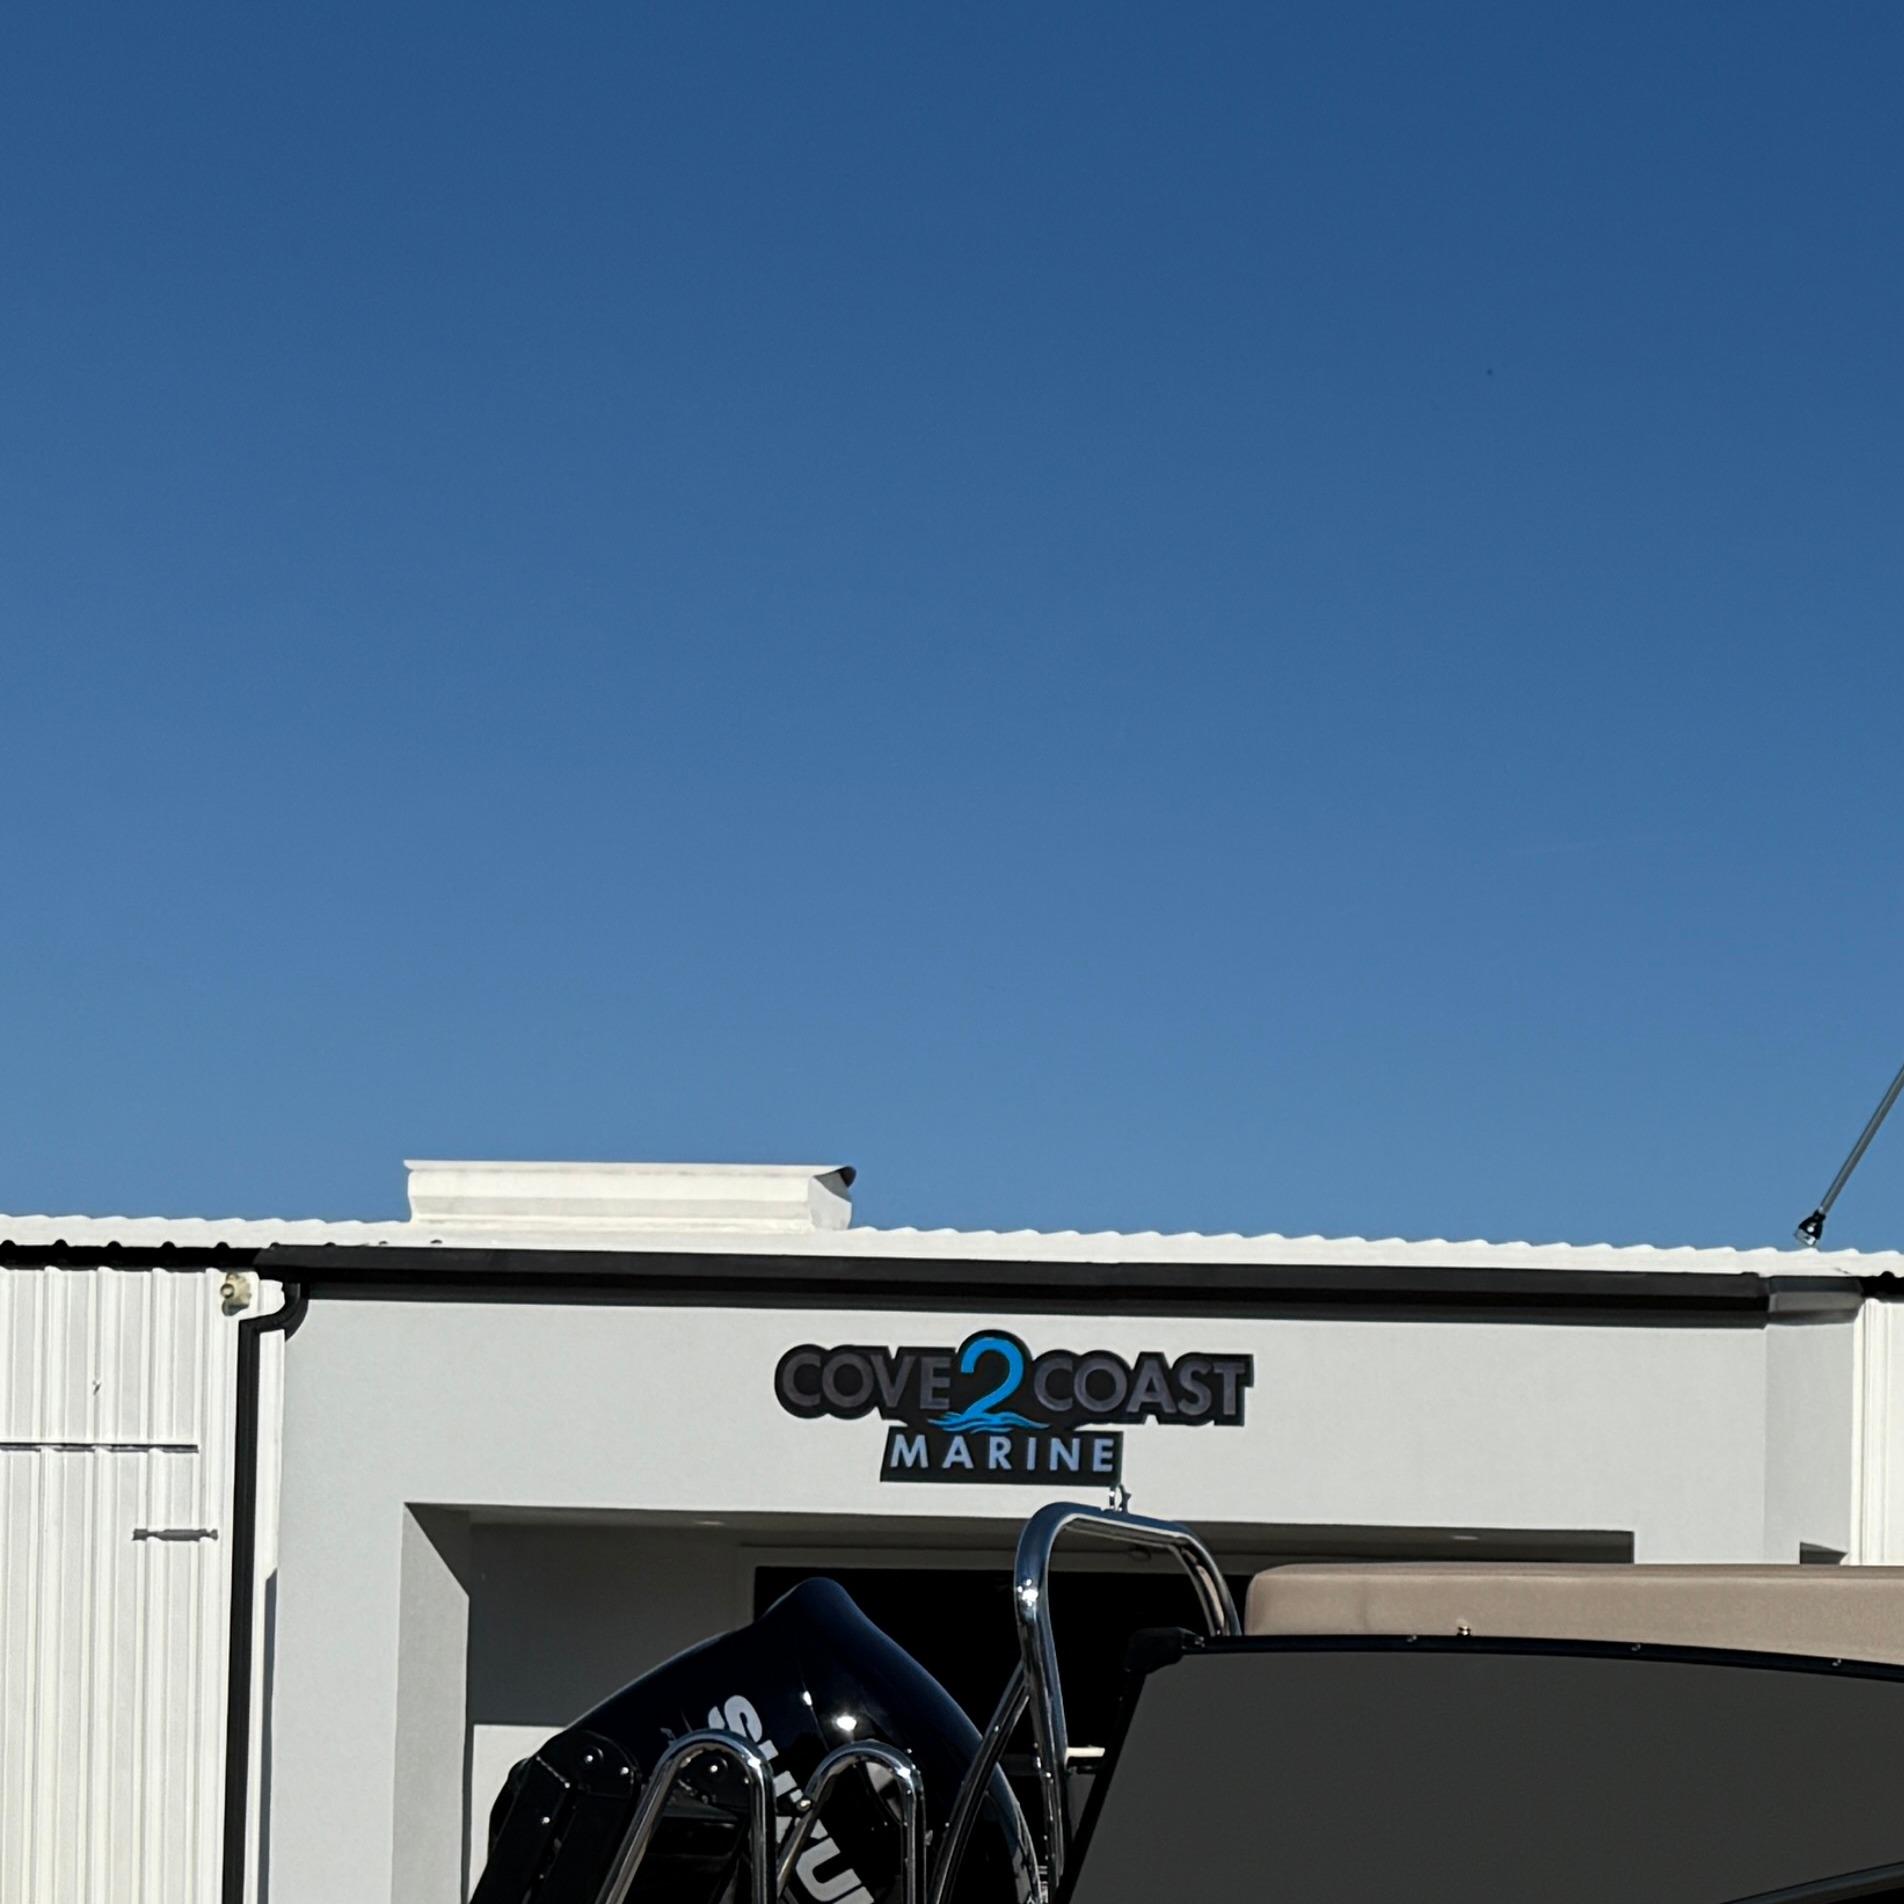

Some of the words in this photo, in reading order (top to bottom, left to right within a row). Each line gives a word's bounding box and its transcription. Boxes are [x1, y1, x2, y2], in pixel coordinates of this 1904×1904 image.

[781, 1351, 952, 1411] COVE
[960, 1336, 1025, 1419] 2
[1033, 1356, 1251, 1417] COAST
[889, 1433, 1115, 1474] MARINE
